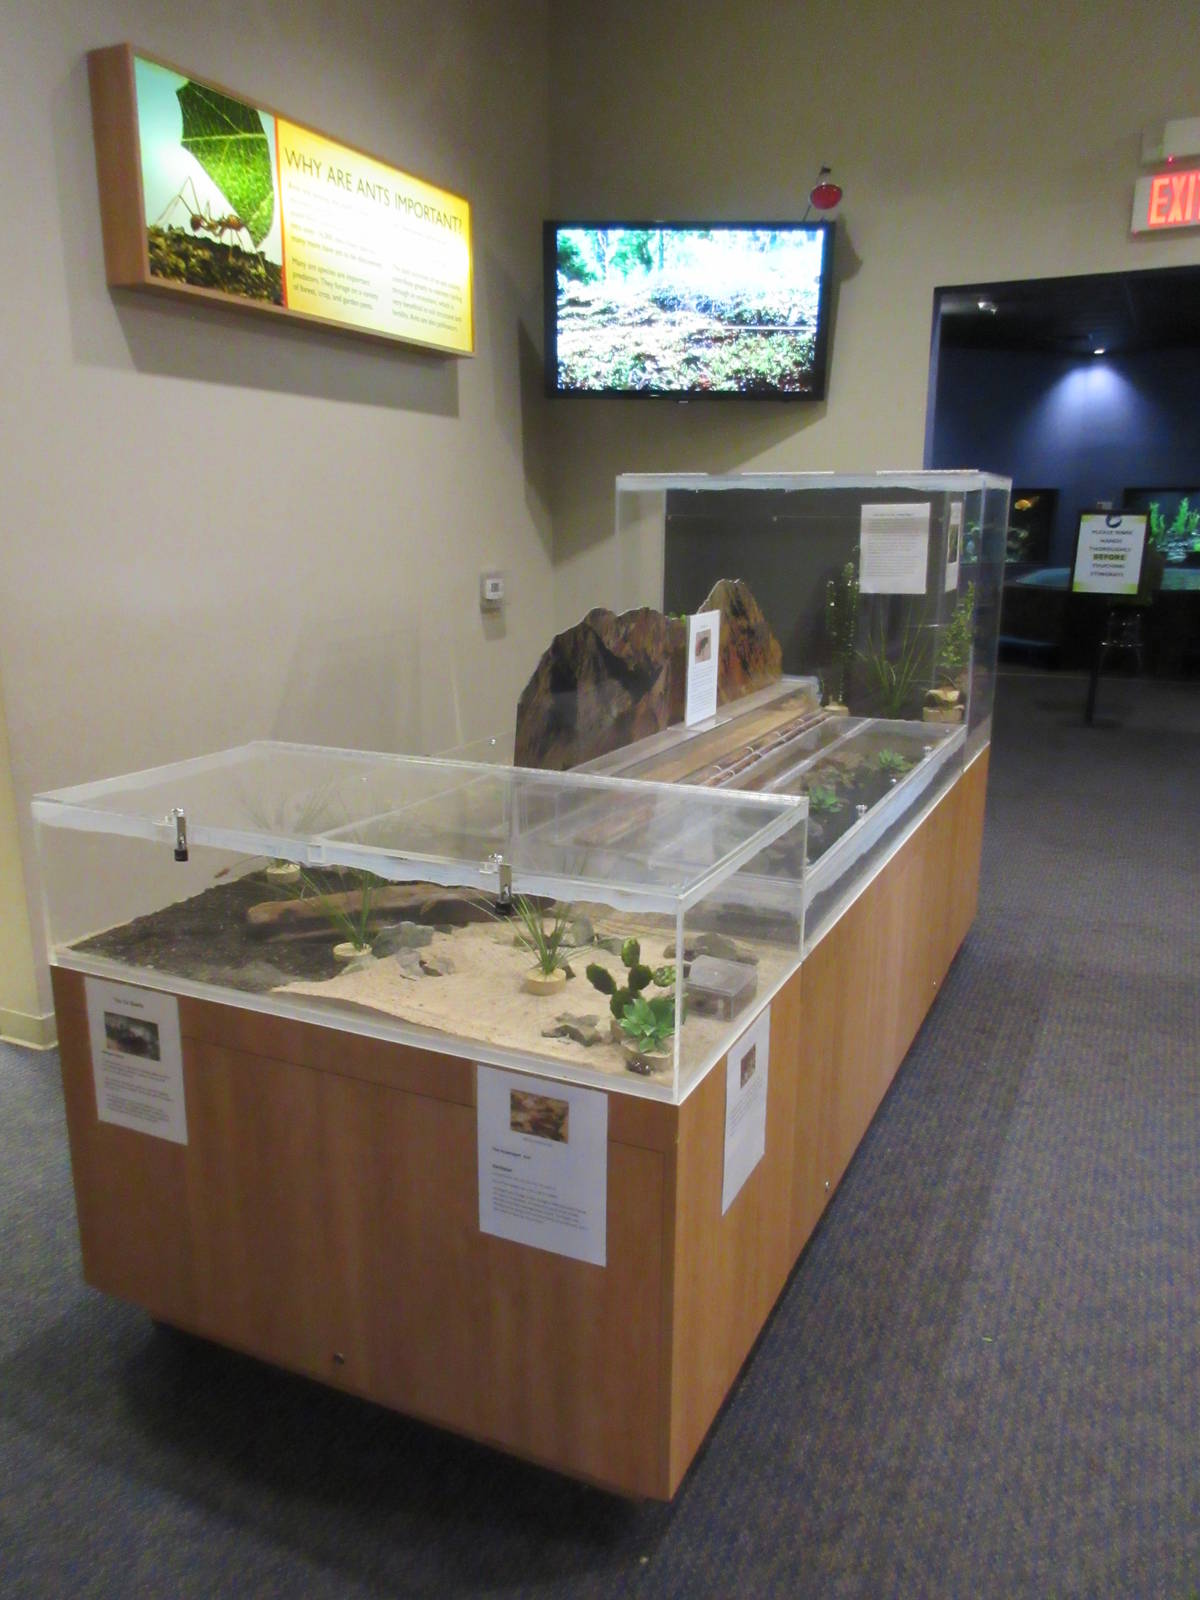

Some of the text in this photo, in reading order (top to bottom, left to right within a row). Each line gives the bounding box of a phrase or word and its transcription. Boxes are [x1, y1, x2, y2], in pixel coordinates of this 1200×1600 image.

[285, 147, 321, 178] WHY
[327, 166, 353, 192] ARE
[357, 178, 390, 207] ANTS
[1150, 174, 1200, 225] EXI
[1093, 553, 1126, 561] BEFORE
